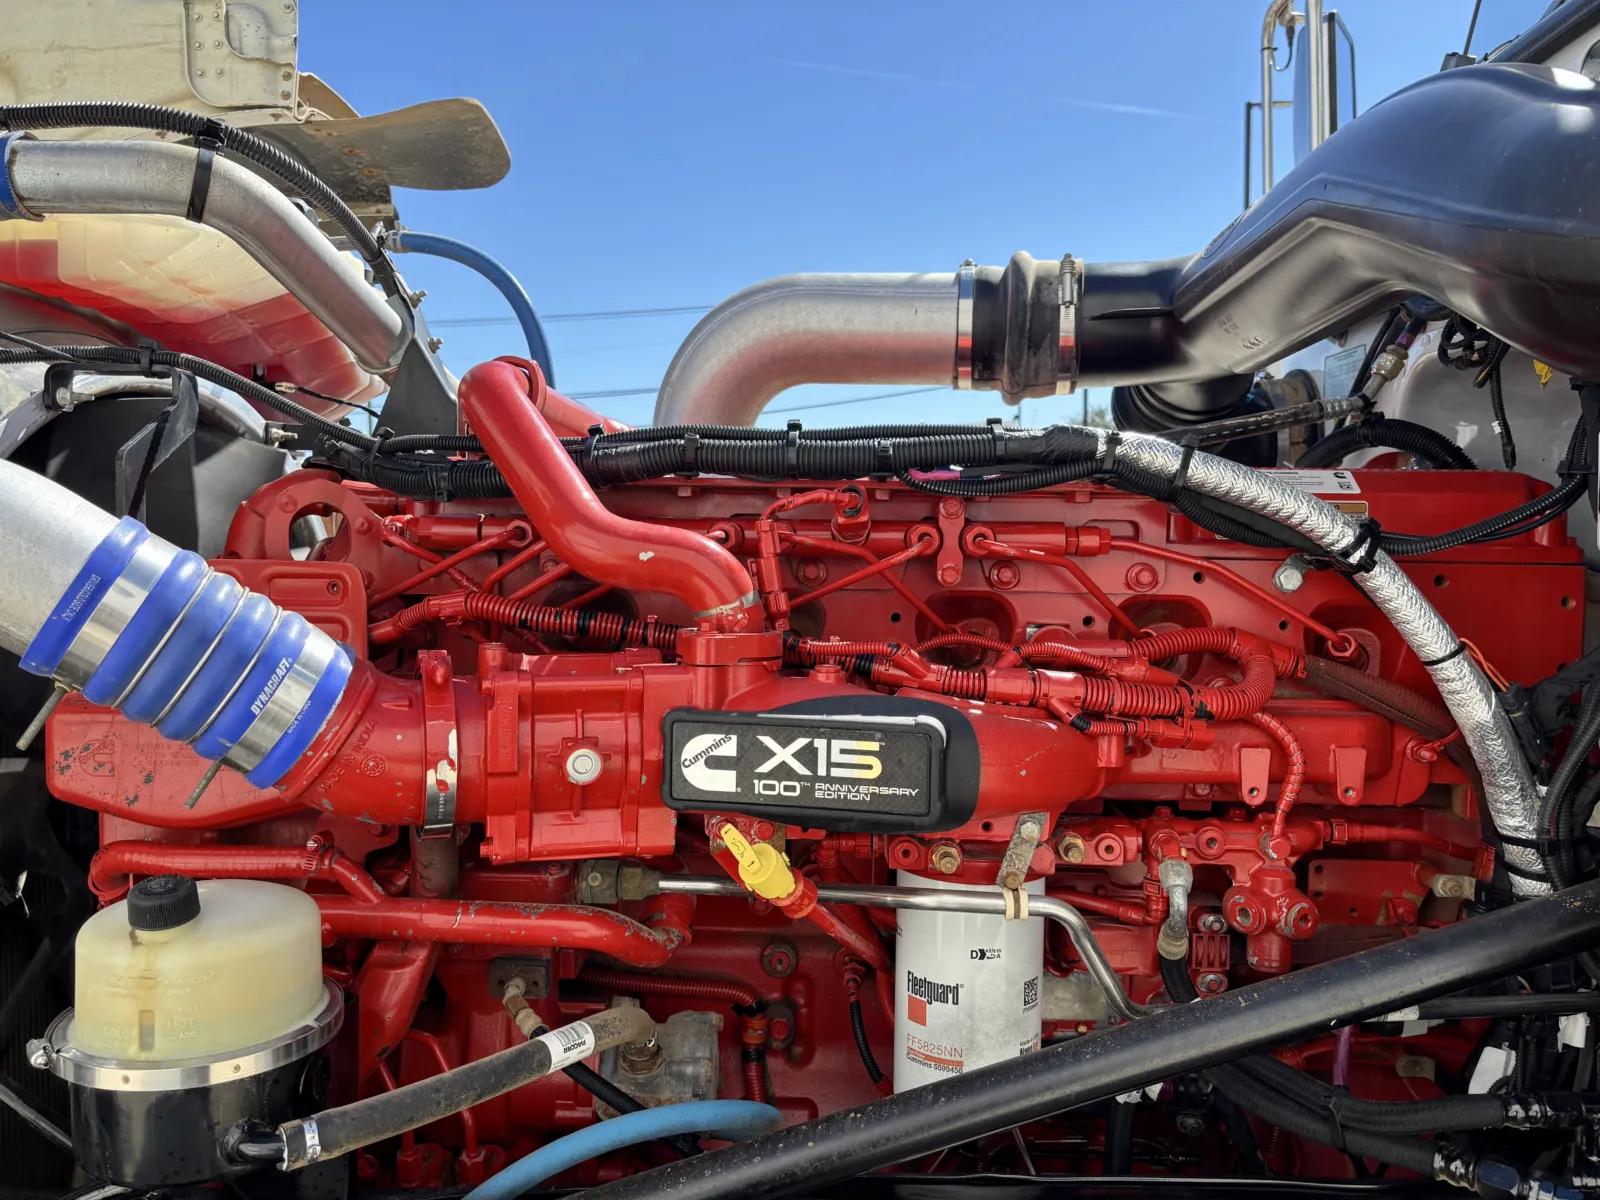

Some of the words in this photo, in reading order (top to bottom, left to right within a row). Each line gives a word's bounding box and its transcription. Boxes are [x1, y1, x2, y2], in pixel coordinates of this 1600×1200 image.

[250, 657, 290, 716] DYNACRAFT
[682, 735, 732, 768] Cummins
[753, 735, 882, 780] X15
[814, 782, 920, 797] ANNIVERSARY
[814, 791, 871, 801] EDITION
[907, 969, 960, 1006] Fleetguard
[563, 1039, 586, 1054] PACCAR
[907, 1033, 963, 1059] FF5825NN
